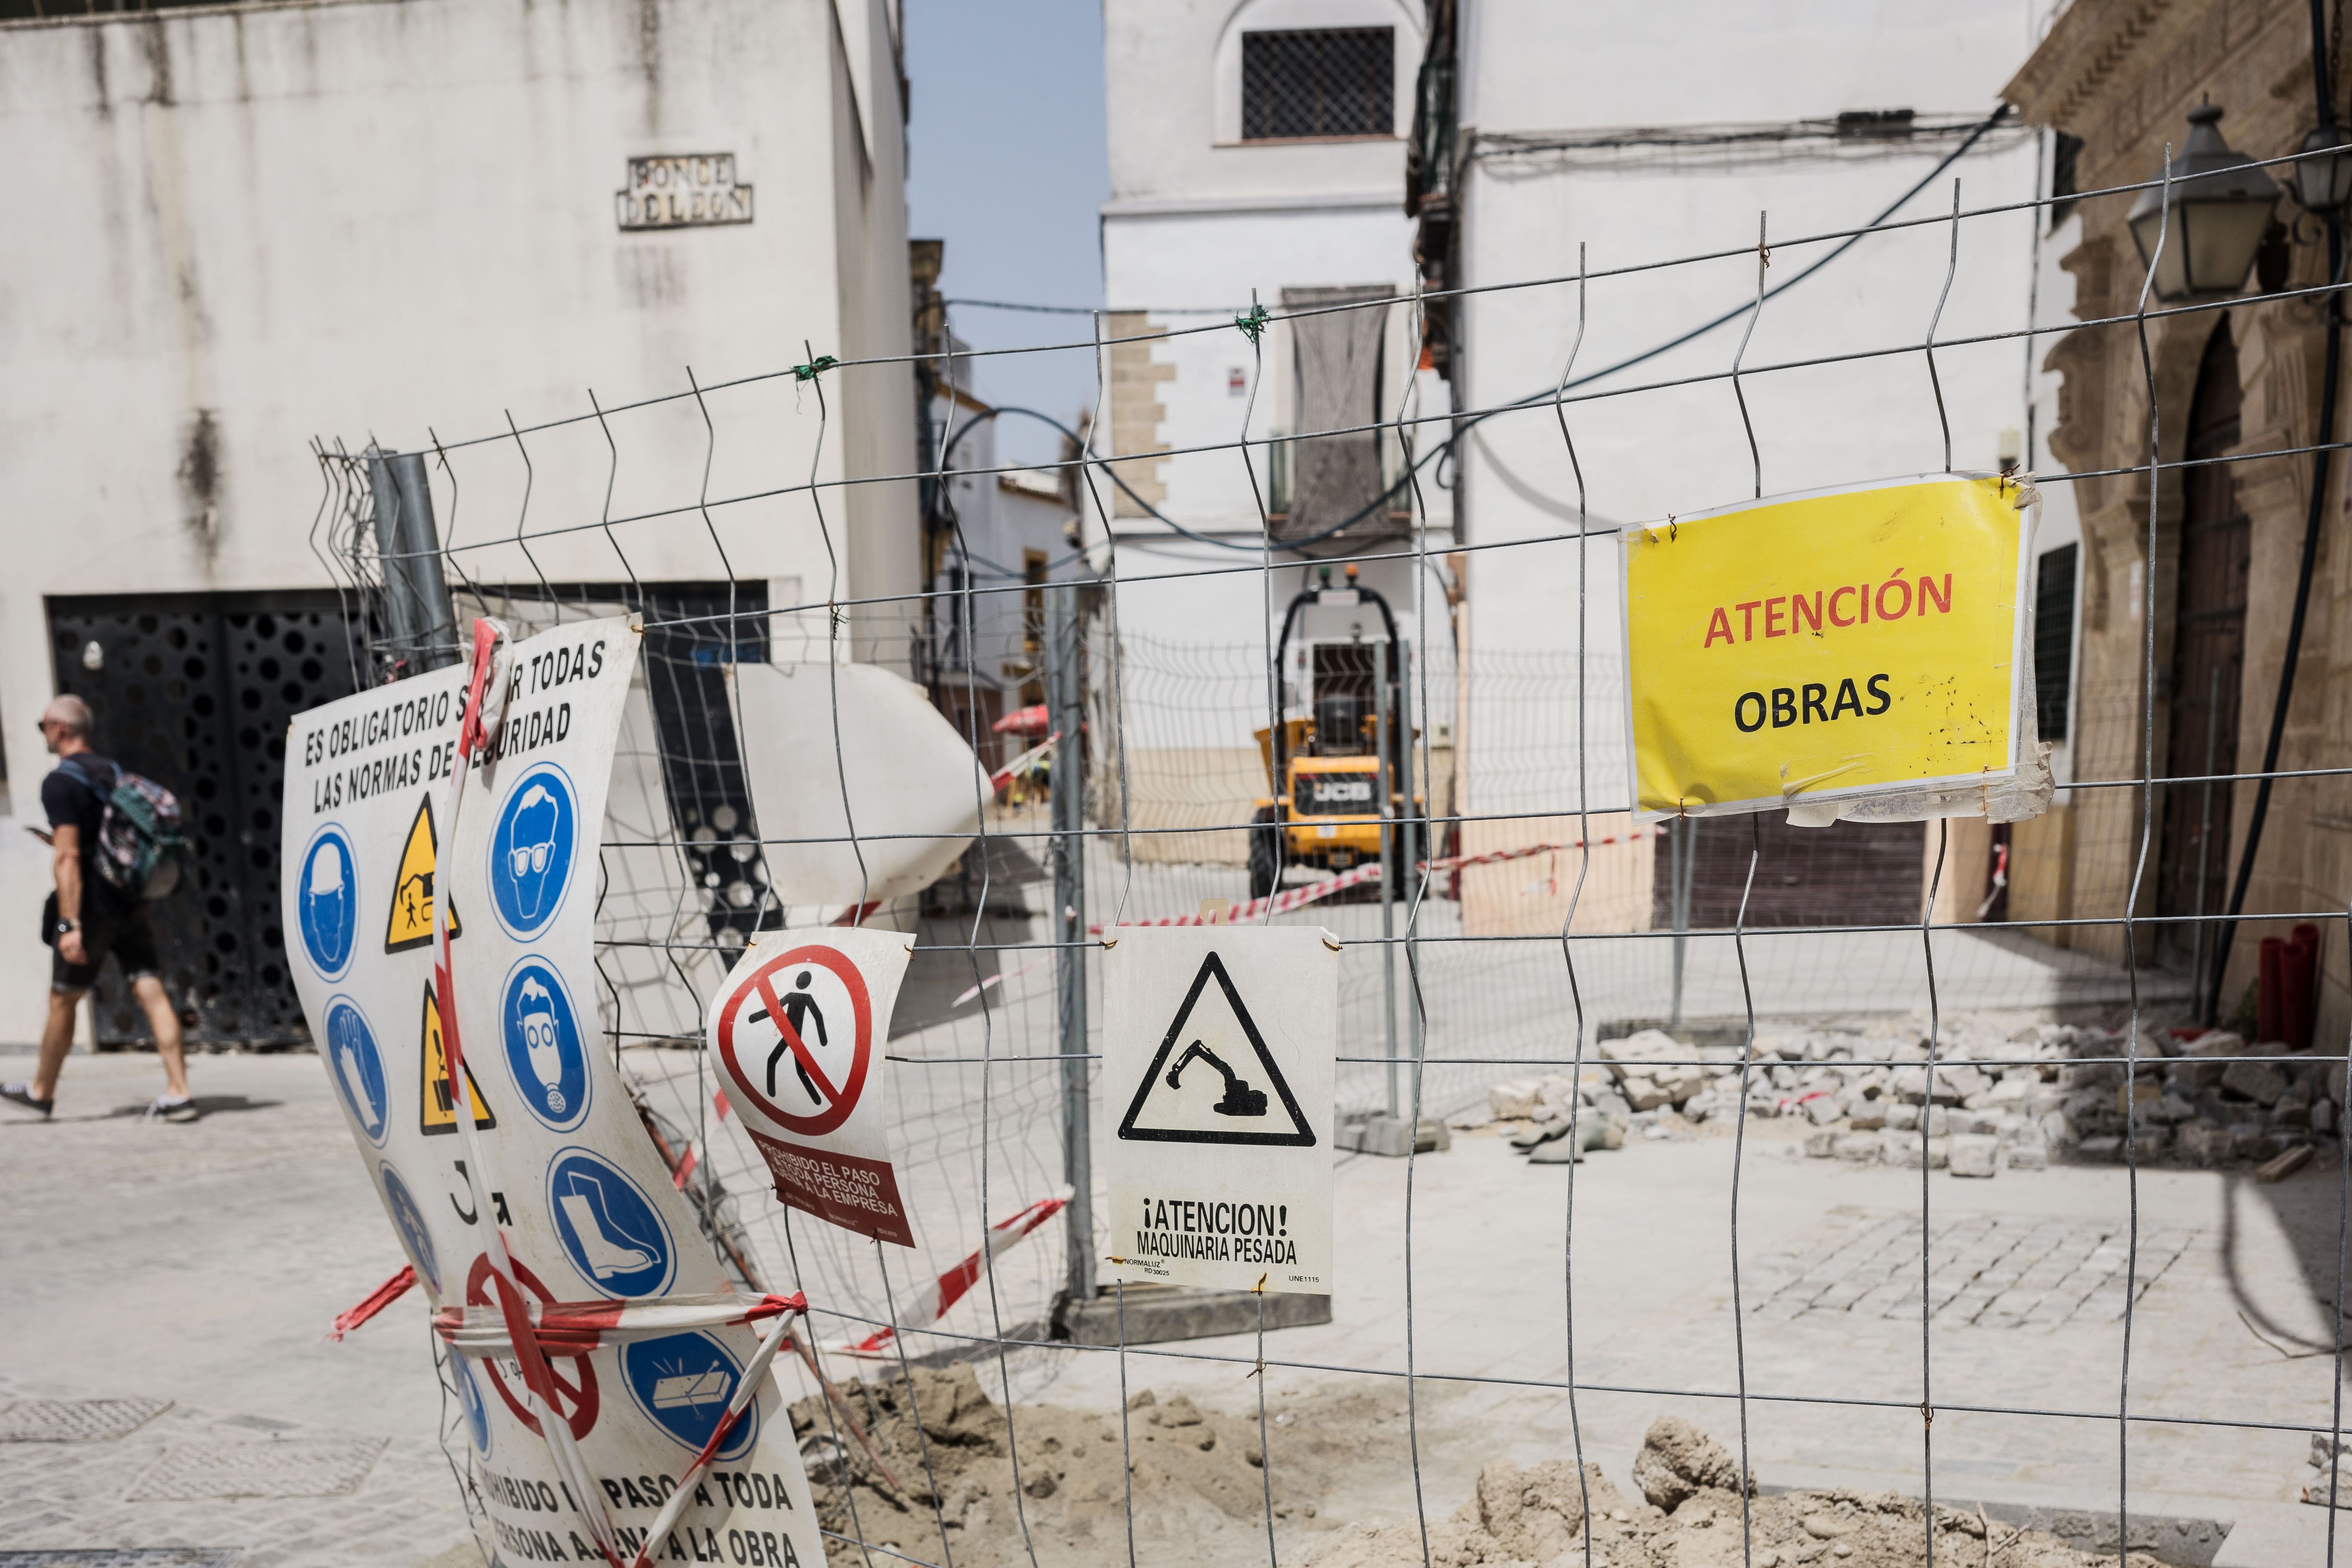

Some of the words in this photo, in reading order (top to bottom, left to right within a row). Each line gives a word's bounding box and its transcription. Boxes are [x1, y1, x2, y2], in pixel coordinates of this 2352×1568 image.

[1703, 567, 1953, 649] ATENCIÓN
[306, 729, 324, 766] ES
[330, 691, 449, 759] OBLIGATORIO
[531, 640, 605, 694] TODAS
[1734, 673, 1892, 733] OBRAS
[315, 773, 342, 813] LAS
[348, 749, 421, 803] NORMAS
[428, 741, 455, 781] DE
[757, 1139, 820, 1173] PROHIBIDO
[821, 1162, 841, 1178] EL
[841, 1166, 880, 1186] PASO
[774, 1156, 783, 1168] A
[781, 1160, 814, 1183] TODA
[814, 1173, 879, 1199] PERSONA
[804, 1181, 815, 1194] A
[813, 1184, 833, 1200] LA
[832, 1190, 898, 1217] EMPRESA
[1143, 1197, 1287, 1237] ¡ATENCION!
[1137, 1231, 1230, 1262] MAQUINARIA
[1234, 1237, 1297, 1265] PESADA
[693, 1482, 714, 1507] A
[712, 1472, 793, 1510] TODA
[686, 1526, 725, 1564] LA
[729, 1528, 801, 1568] OBRA
